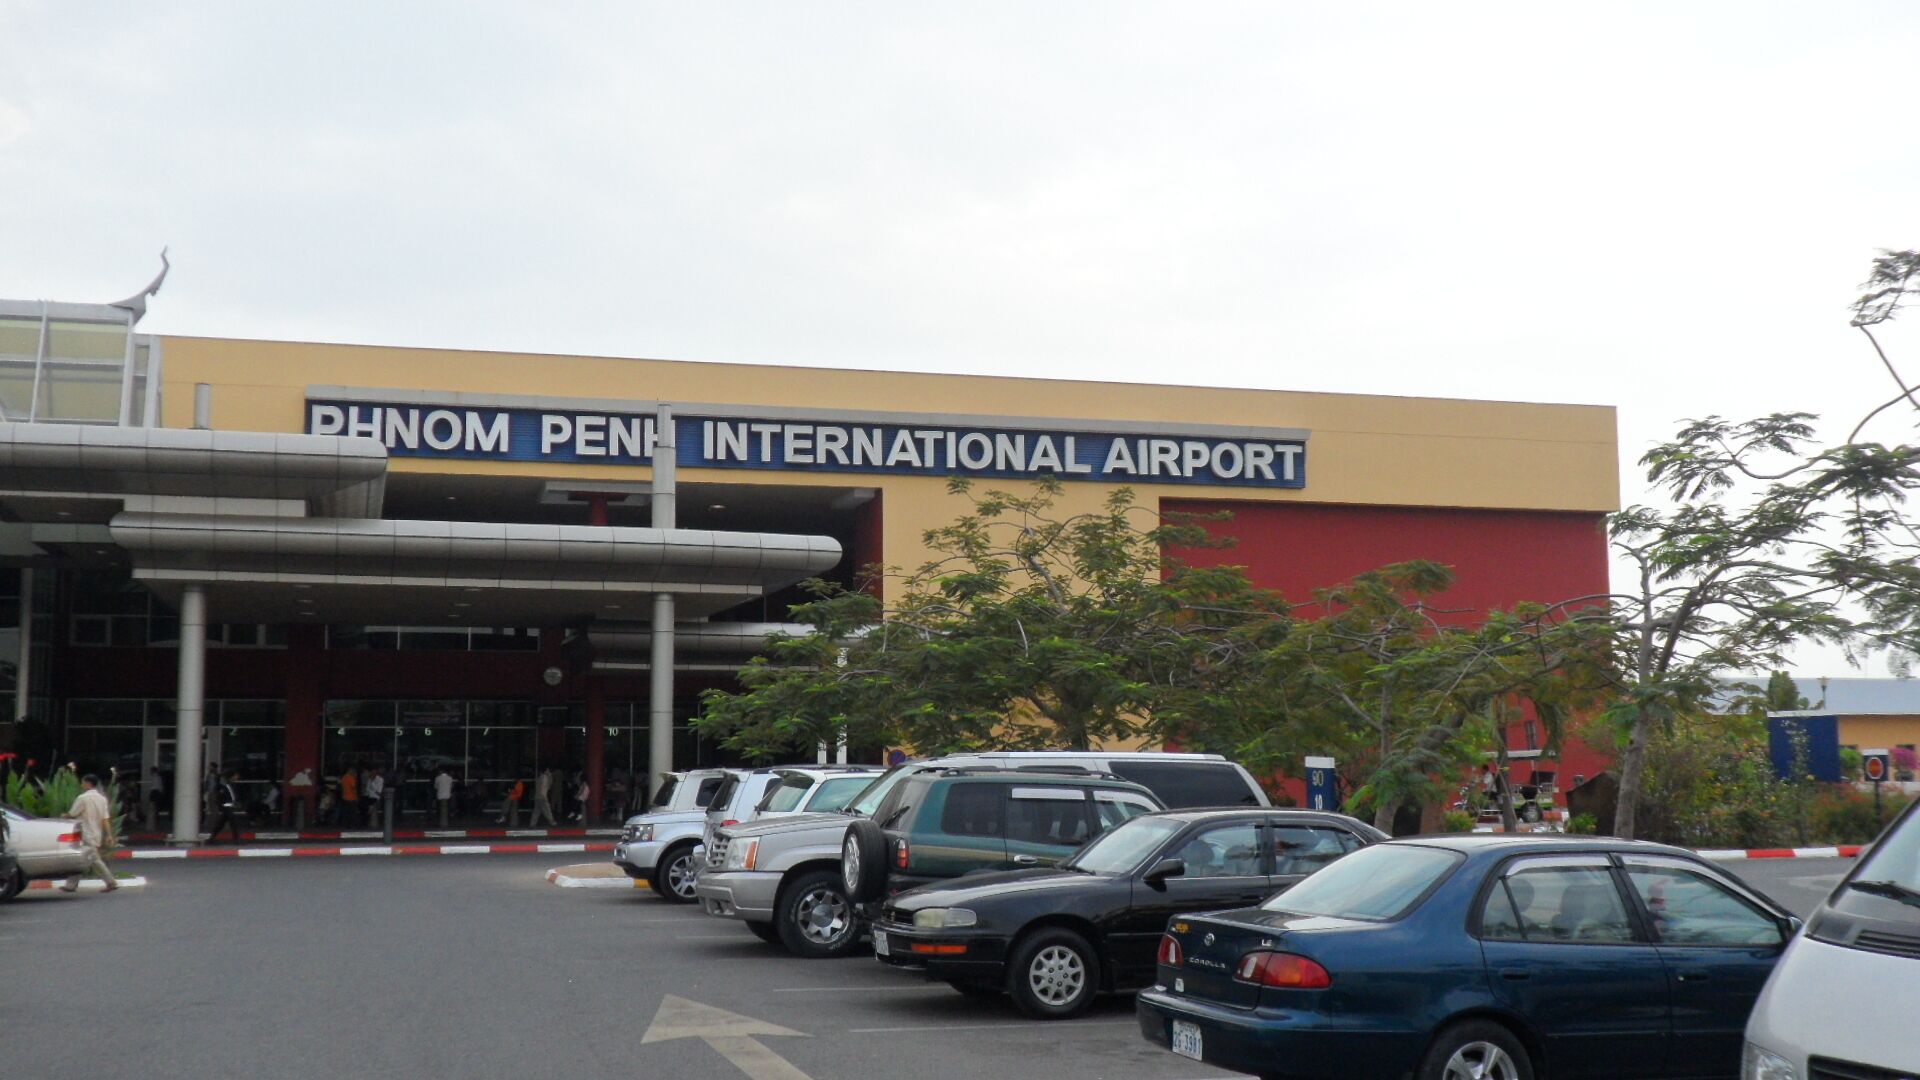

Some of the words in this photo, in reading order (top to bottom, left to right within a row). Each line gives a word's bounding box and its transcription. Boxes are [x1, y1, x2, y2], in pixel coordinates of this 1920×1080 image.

[311, 404, 509, 453] PHNOM
[702, 420, 1093, 474] INTERNATIONAL
[1102, 436, 1303, 480] AIRPORT
[424, 727, 432, 736] 6
[608, 727, 619, 736] 10
[1261, 938, 1273, 947] LE
[1188, 956, 1227, 969] COROLLA
